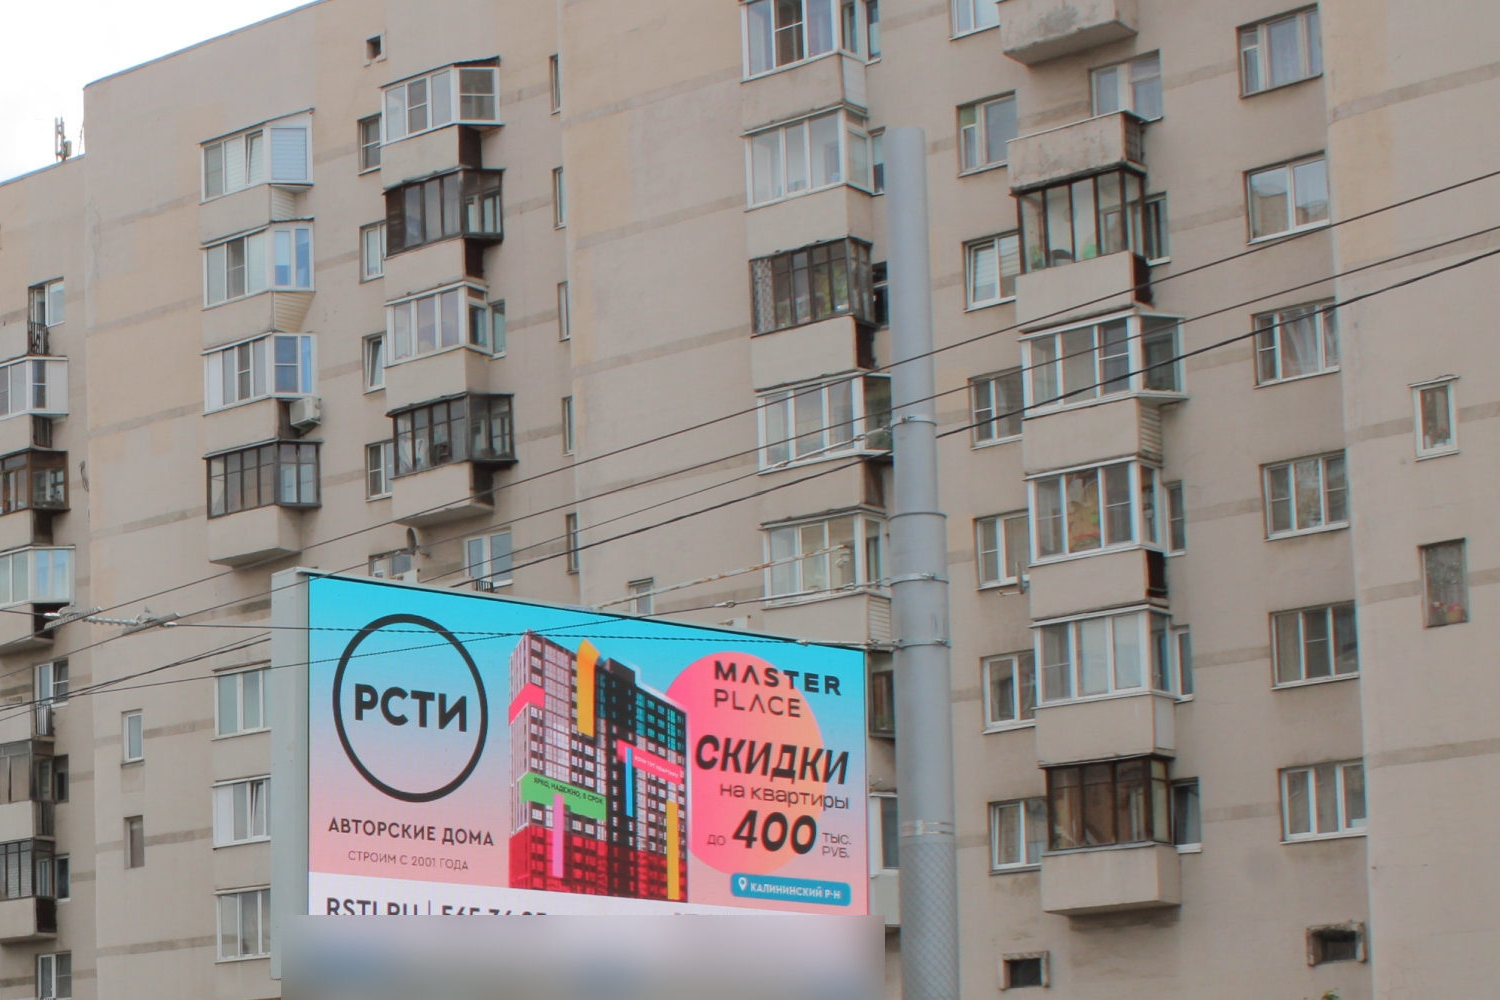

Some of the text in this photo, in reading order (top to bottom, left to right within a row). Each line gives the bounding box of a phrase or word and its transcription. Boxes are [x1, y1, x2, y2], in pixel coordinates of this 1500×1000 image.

[714, 660, 842, 696] MASTER
[354, 683, 467, 733] РСТИ
[714, 688, 801, 718] PLACE
[695, 734, 849, 785] СКИДКИ
[720, 784, 849, 811] на квартиры
[328, 816, 494, 847] АВТОРСКИЕ ДОМА
[732, 809, 818, 855] 400
[347, 850, 469, 871] СТРОИМ С 2001 ГОДА
[750, 881, 823, 898] КАЛИНИНСКИЙ
